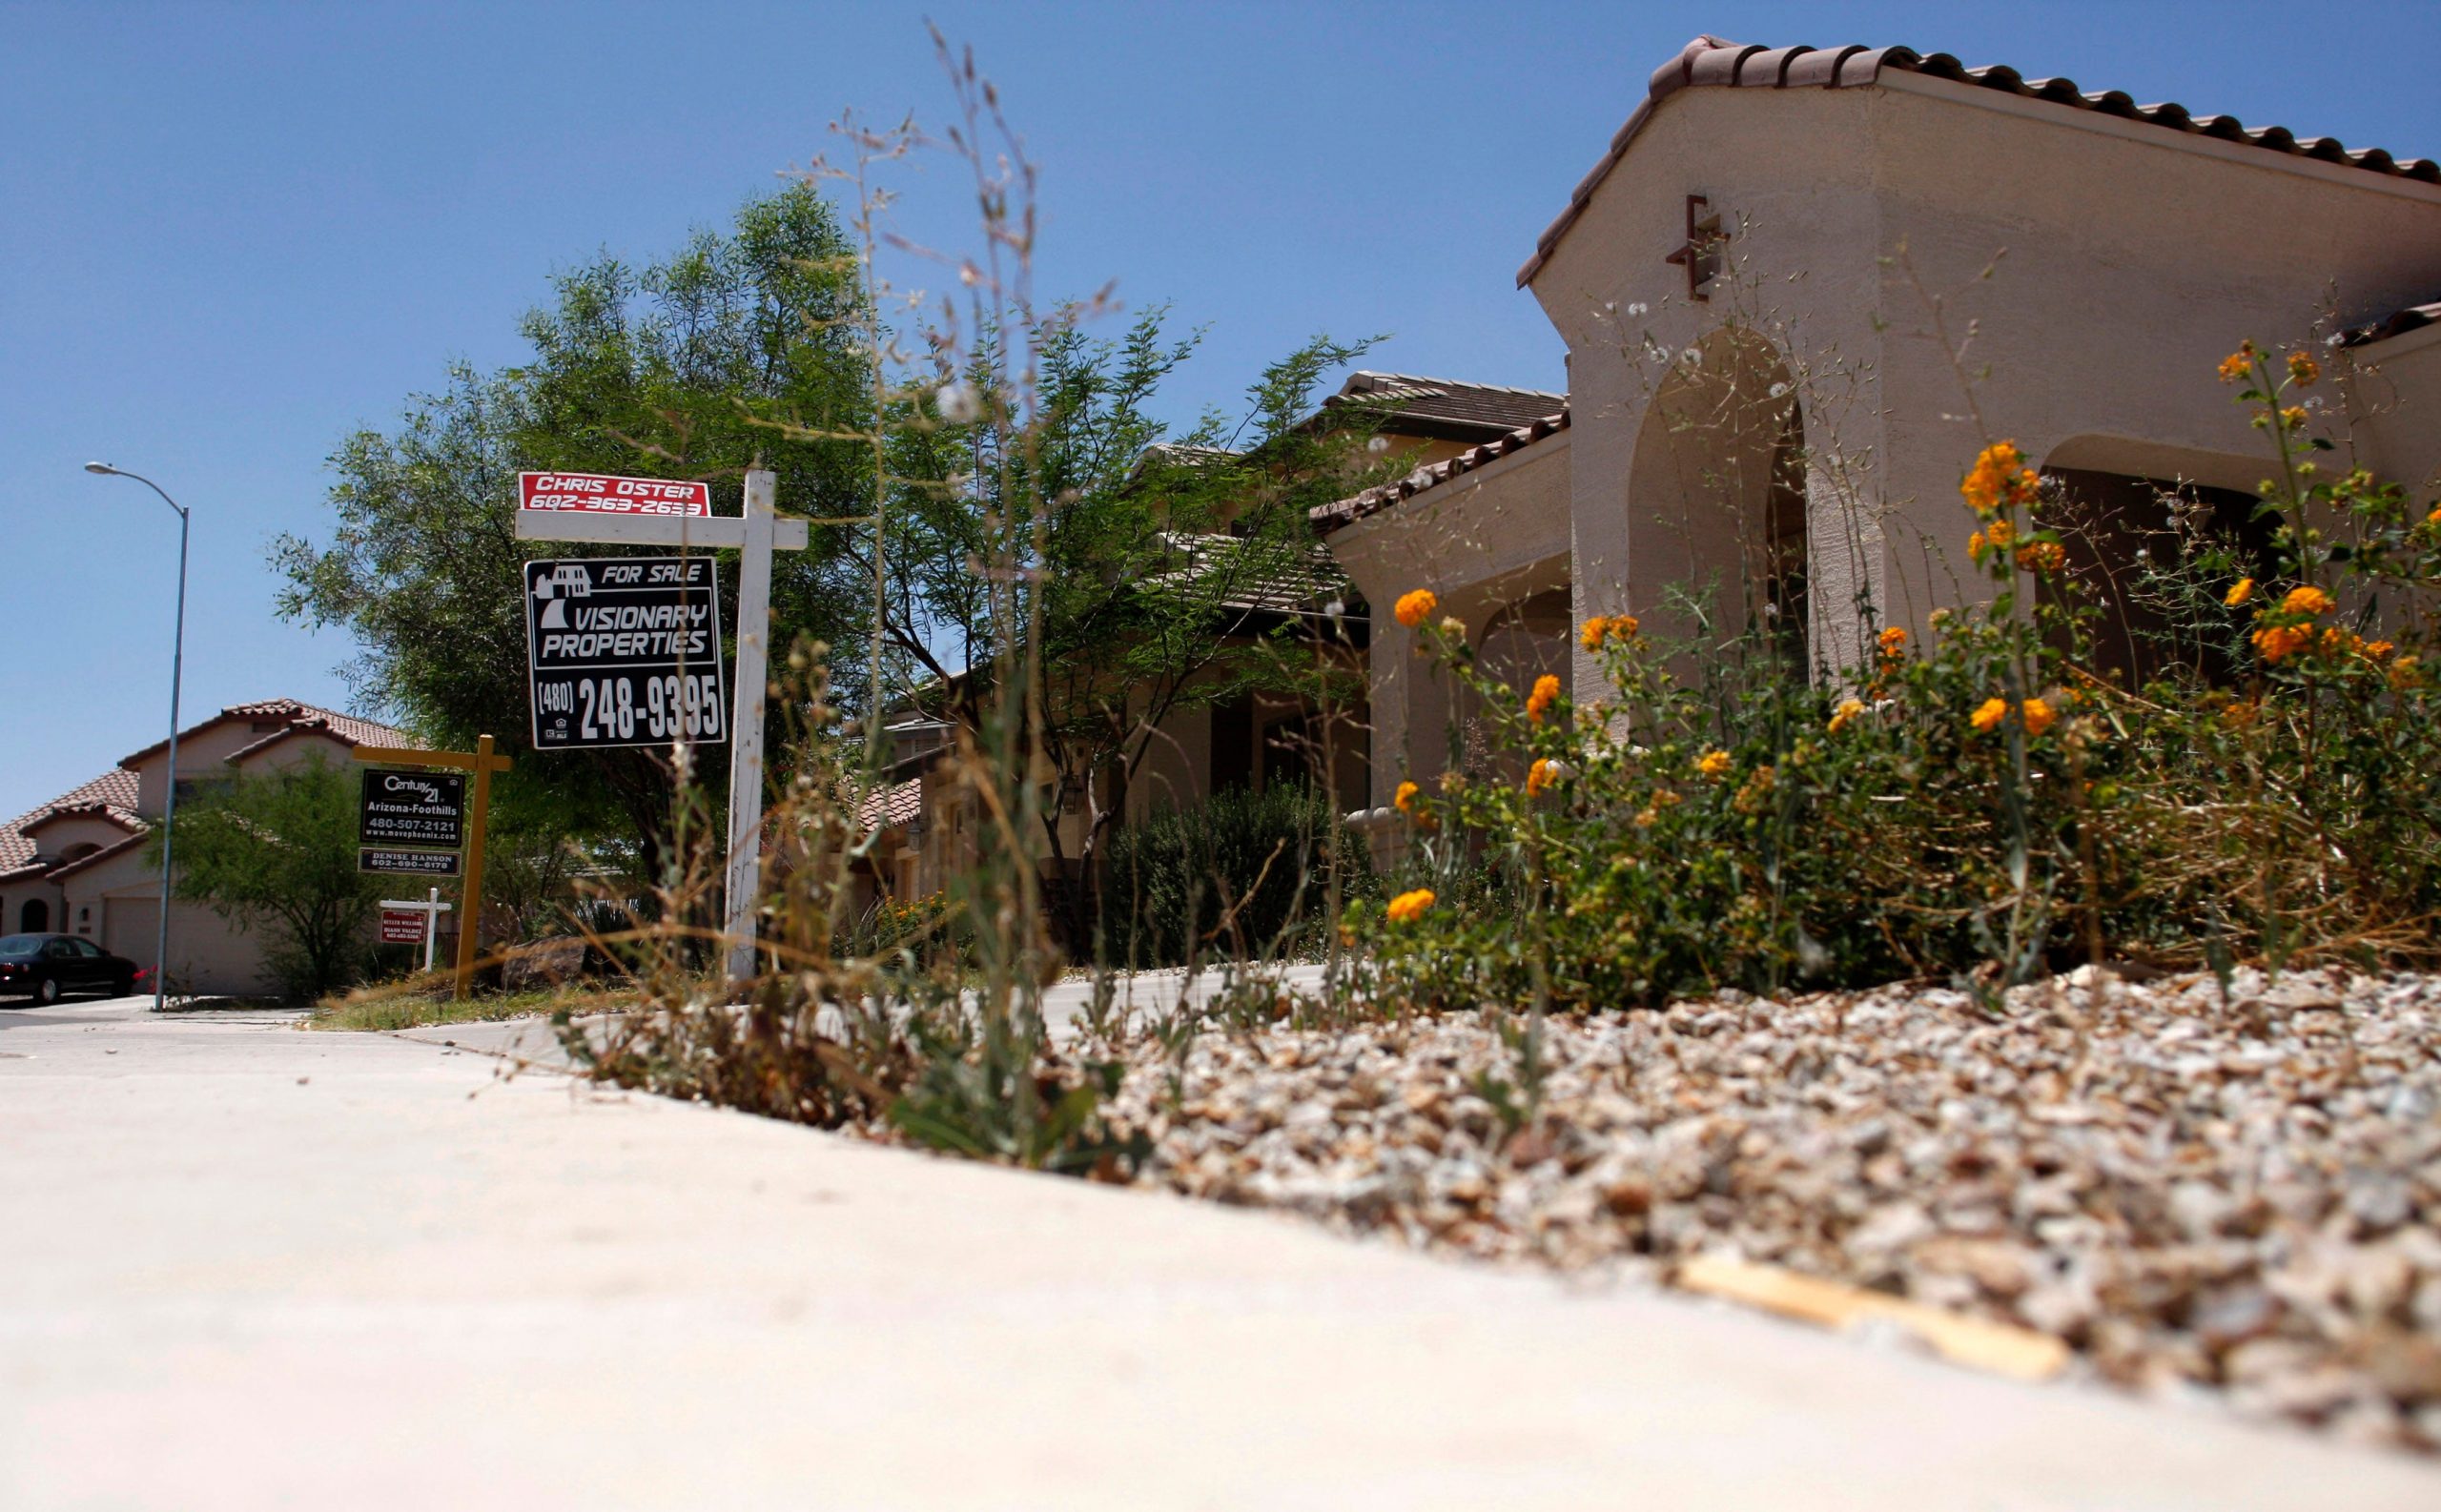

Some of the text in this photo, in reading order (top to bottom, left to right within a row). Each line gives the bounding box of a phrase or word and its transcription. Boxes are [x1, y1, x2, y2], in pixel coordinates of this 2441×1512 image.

[535, 477, 695, 499] CHRIS OSTER
[529, 495, 702, 516] 602-363-2633
[602, 564, 702, 583] FOR SALE
[575, 604, 708, 630] VISIONARY
[542, 630, 708, 658] PROPERTIES
[579, 675, 719, 739] 248-9395
[424, 788, 439, 803] 21
[367, 802, 458, 816] Arizona-Foothills
[365, 829, 457, 839] www.movephoenix.com
[369, 818, 455, 831] 480-507-2121
[373, 852, 452, 863] DENISE HANSON
